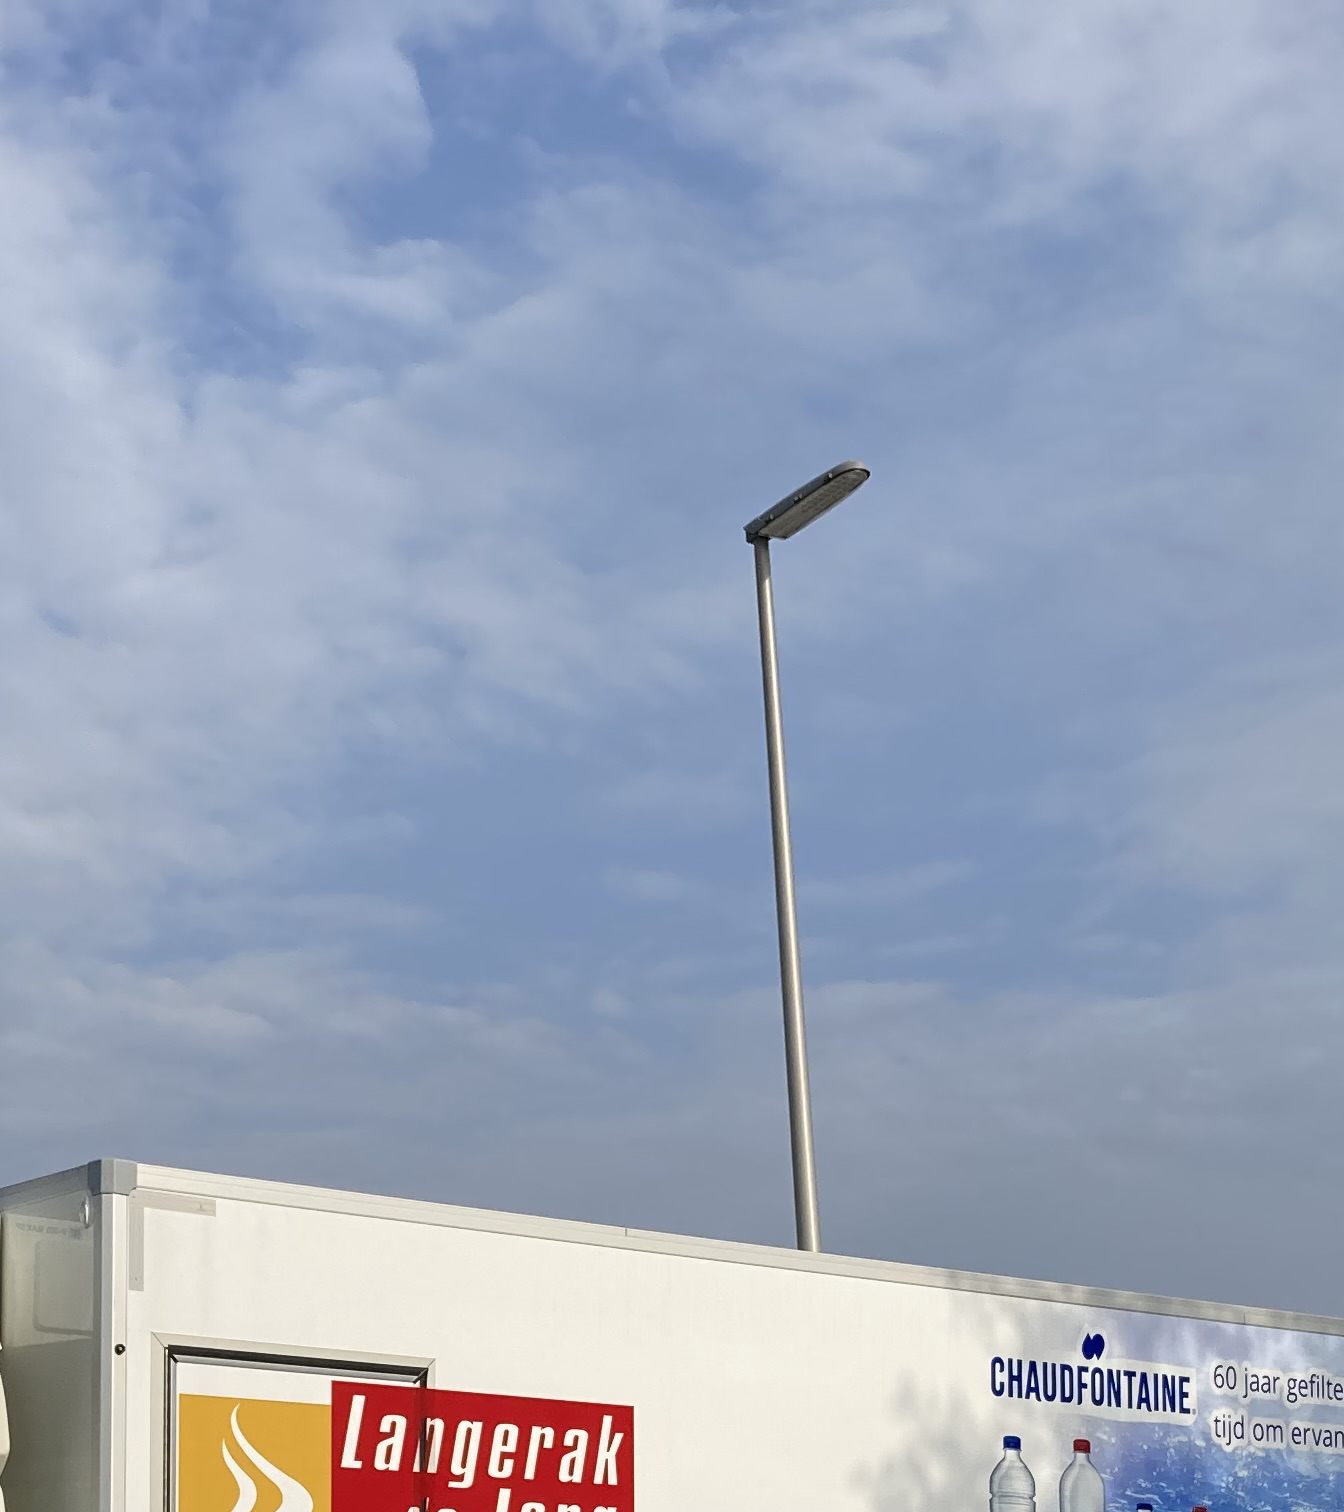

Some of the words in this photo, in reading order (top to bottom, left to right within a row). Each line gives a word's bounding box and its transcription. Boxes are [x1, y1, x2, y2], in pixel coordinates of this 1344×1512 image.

[991, 1356, 1191, 1415] CHAUDFONTAINE
[1213, 1364, 1237, 1390] 60
[1243, 1367, 1281, 1399] jaar
[340, 1395, 624, 1488] Langerak
[1213, 1414, 1245, 1446] tijd
[1252, 1421, 1283, 1443] om
[1291, 1424, 1344, 1448] ervan
